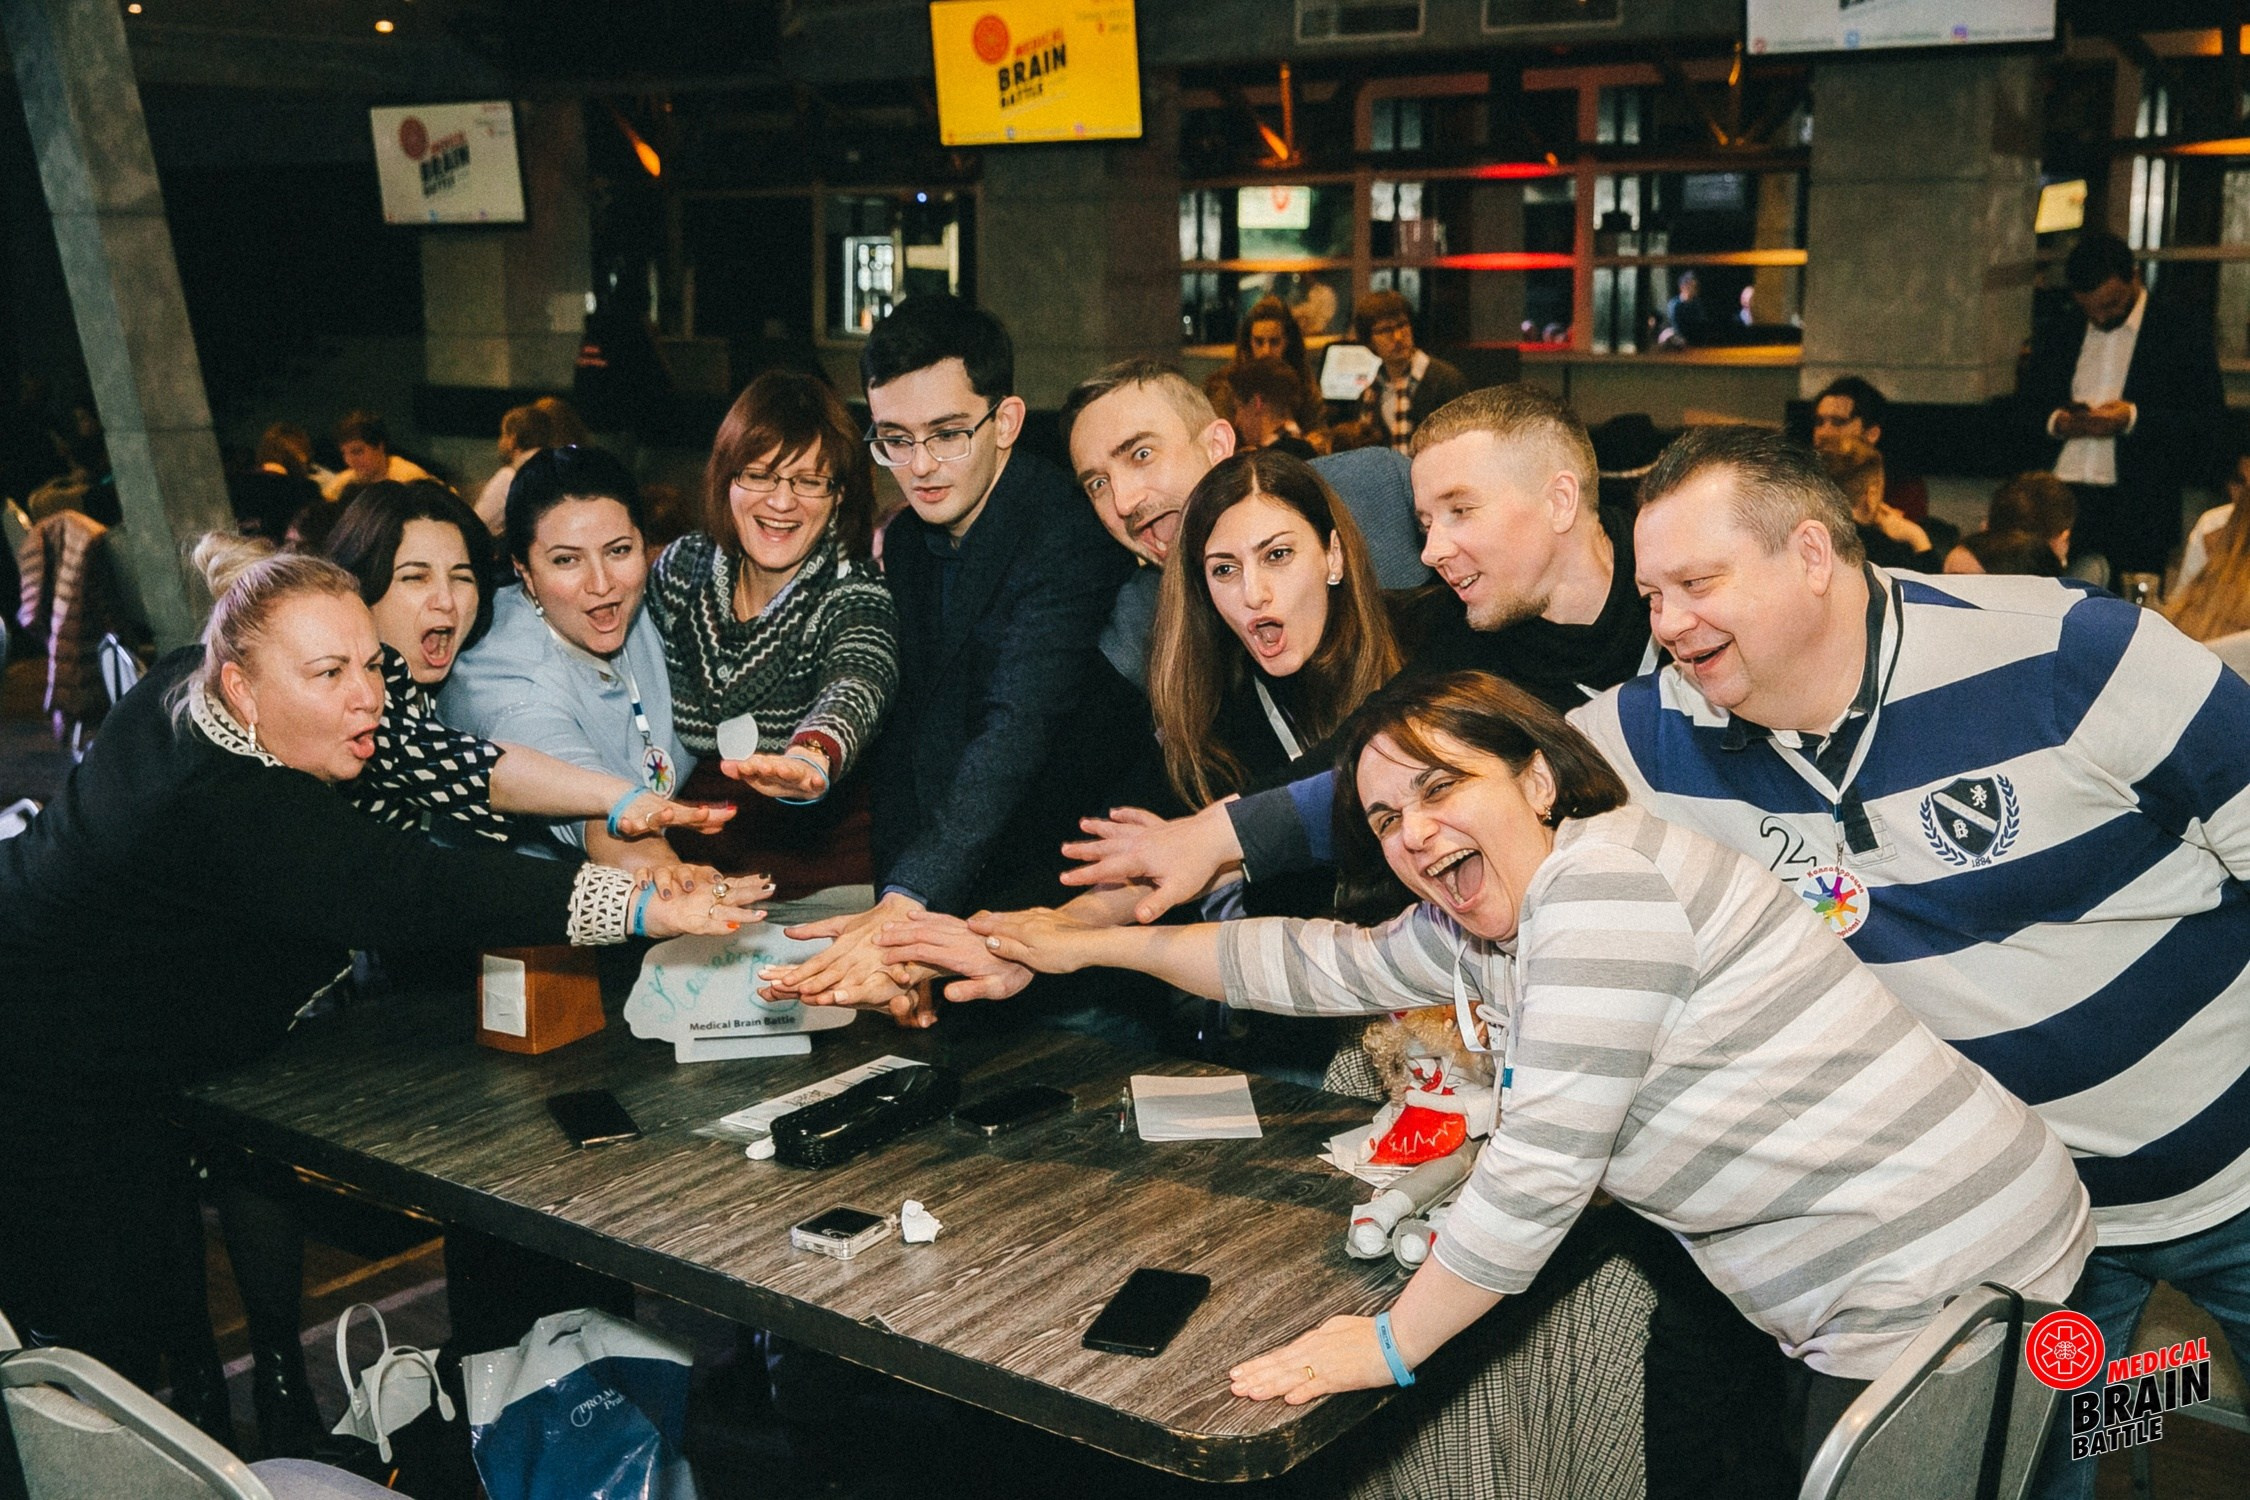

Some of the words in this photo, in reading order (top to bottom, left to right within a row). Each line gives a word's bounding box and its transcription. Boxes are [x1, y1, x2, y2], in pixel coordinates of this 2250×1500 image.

[998, 42, 1066, 92] BRAIN
[1972, 855, 1992, 868] 1884
[689, 1021, 731, 1032] Medical
[733, 1018, 762, 1029] Brain
[764, 1015, 796, 1026] Battle
[578, 1387, 617, 1414] PRO.M
